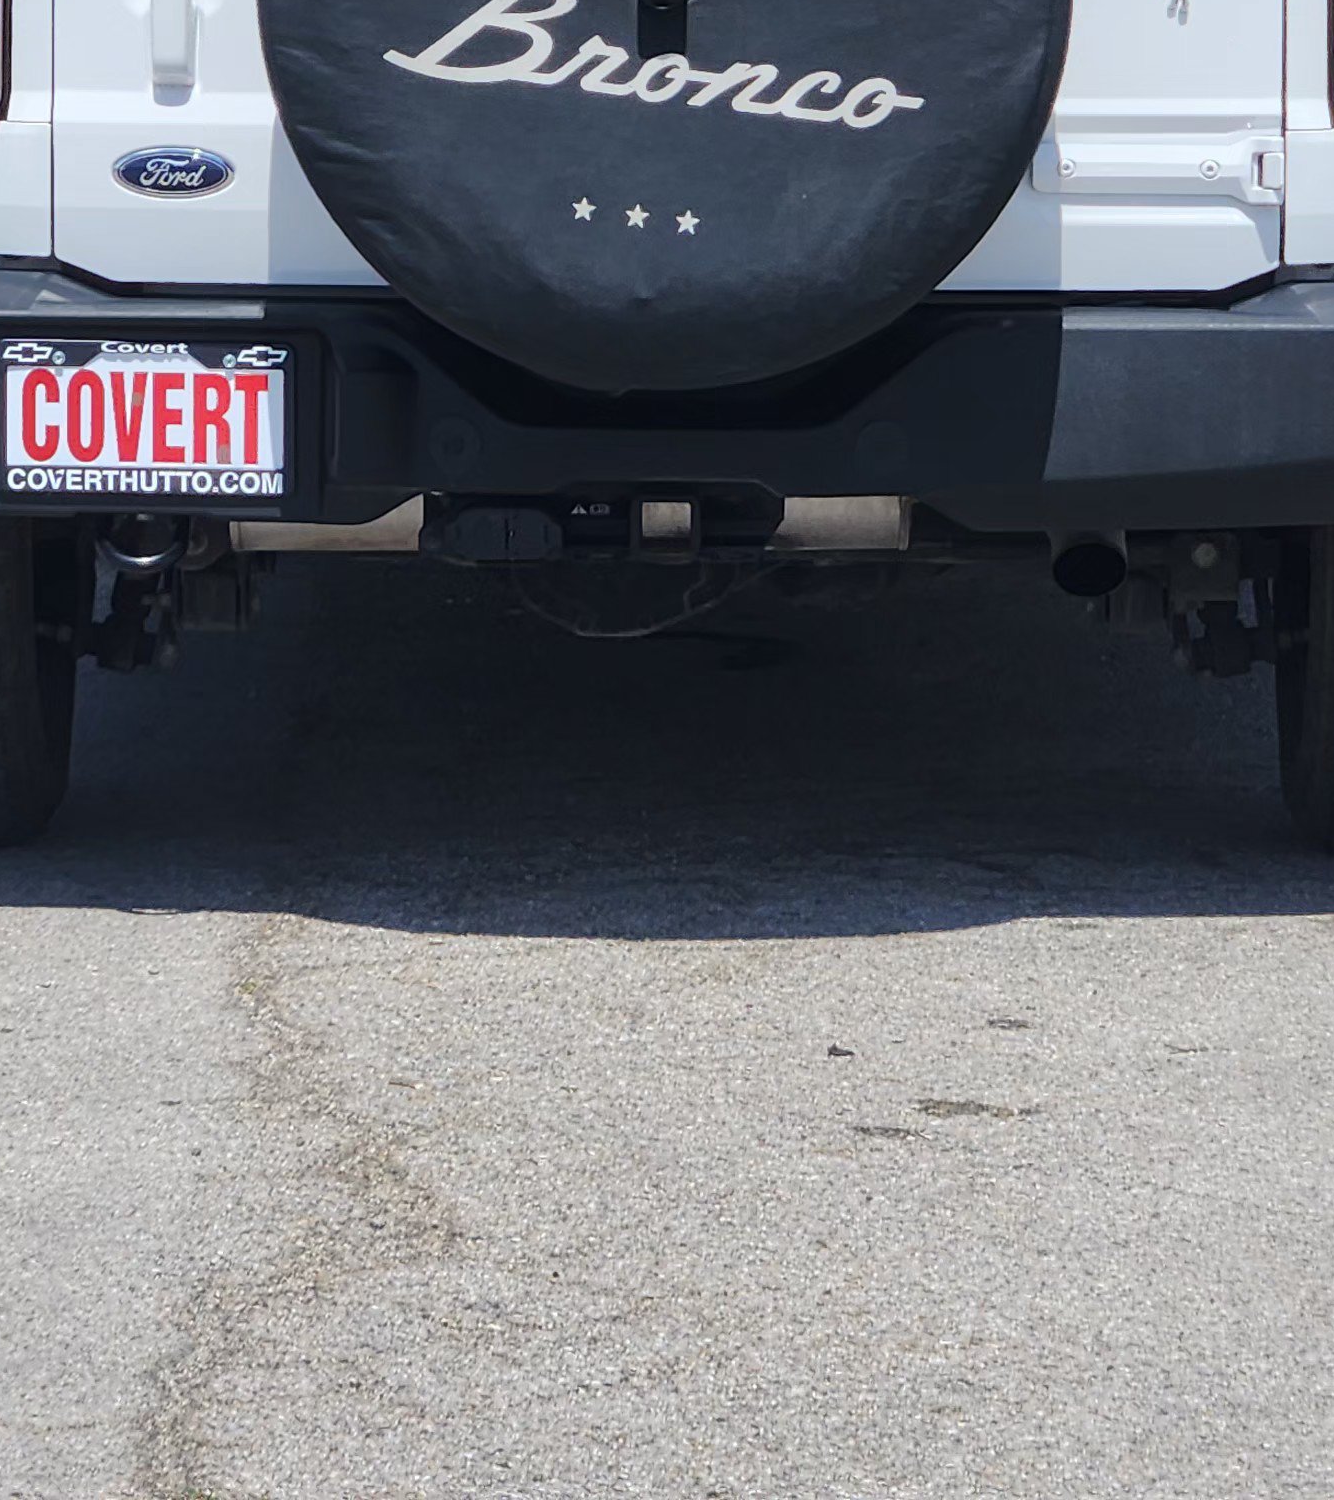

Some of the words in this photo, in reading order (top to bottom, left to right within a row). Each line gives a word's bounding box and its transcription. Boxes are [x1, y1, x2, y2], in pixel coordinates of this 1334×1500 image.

[140, 158, 206, 186] Ford
[101, 342, 188, 354] Covert
[22, 368, 268, 465] COVERT
[7, 468, 283, 494] COVERTHUTTO.COM
